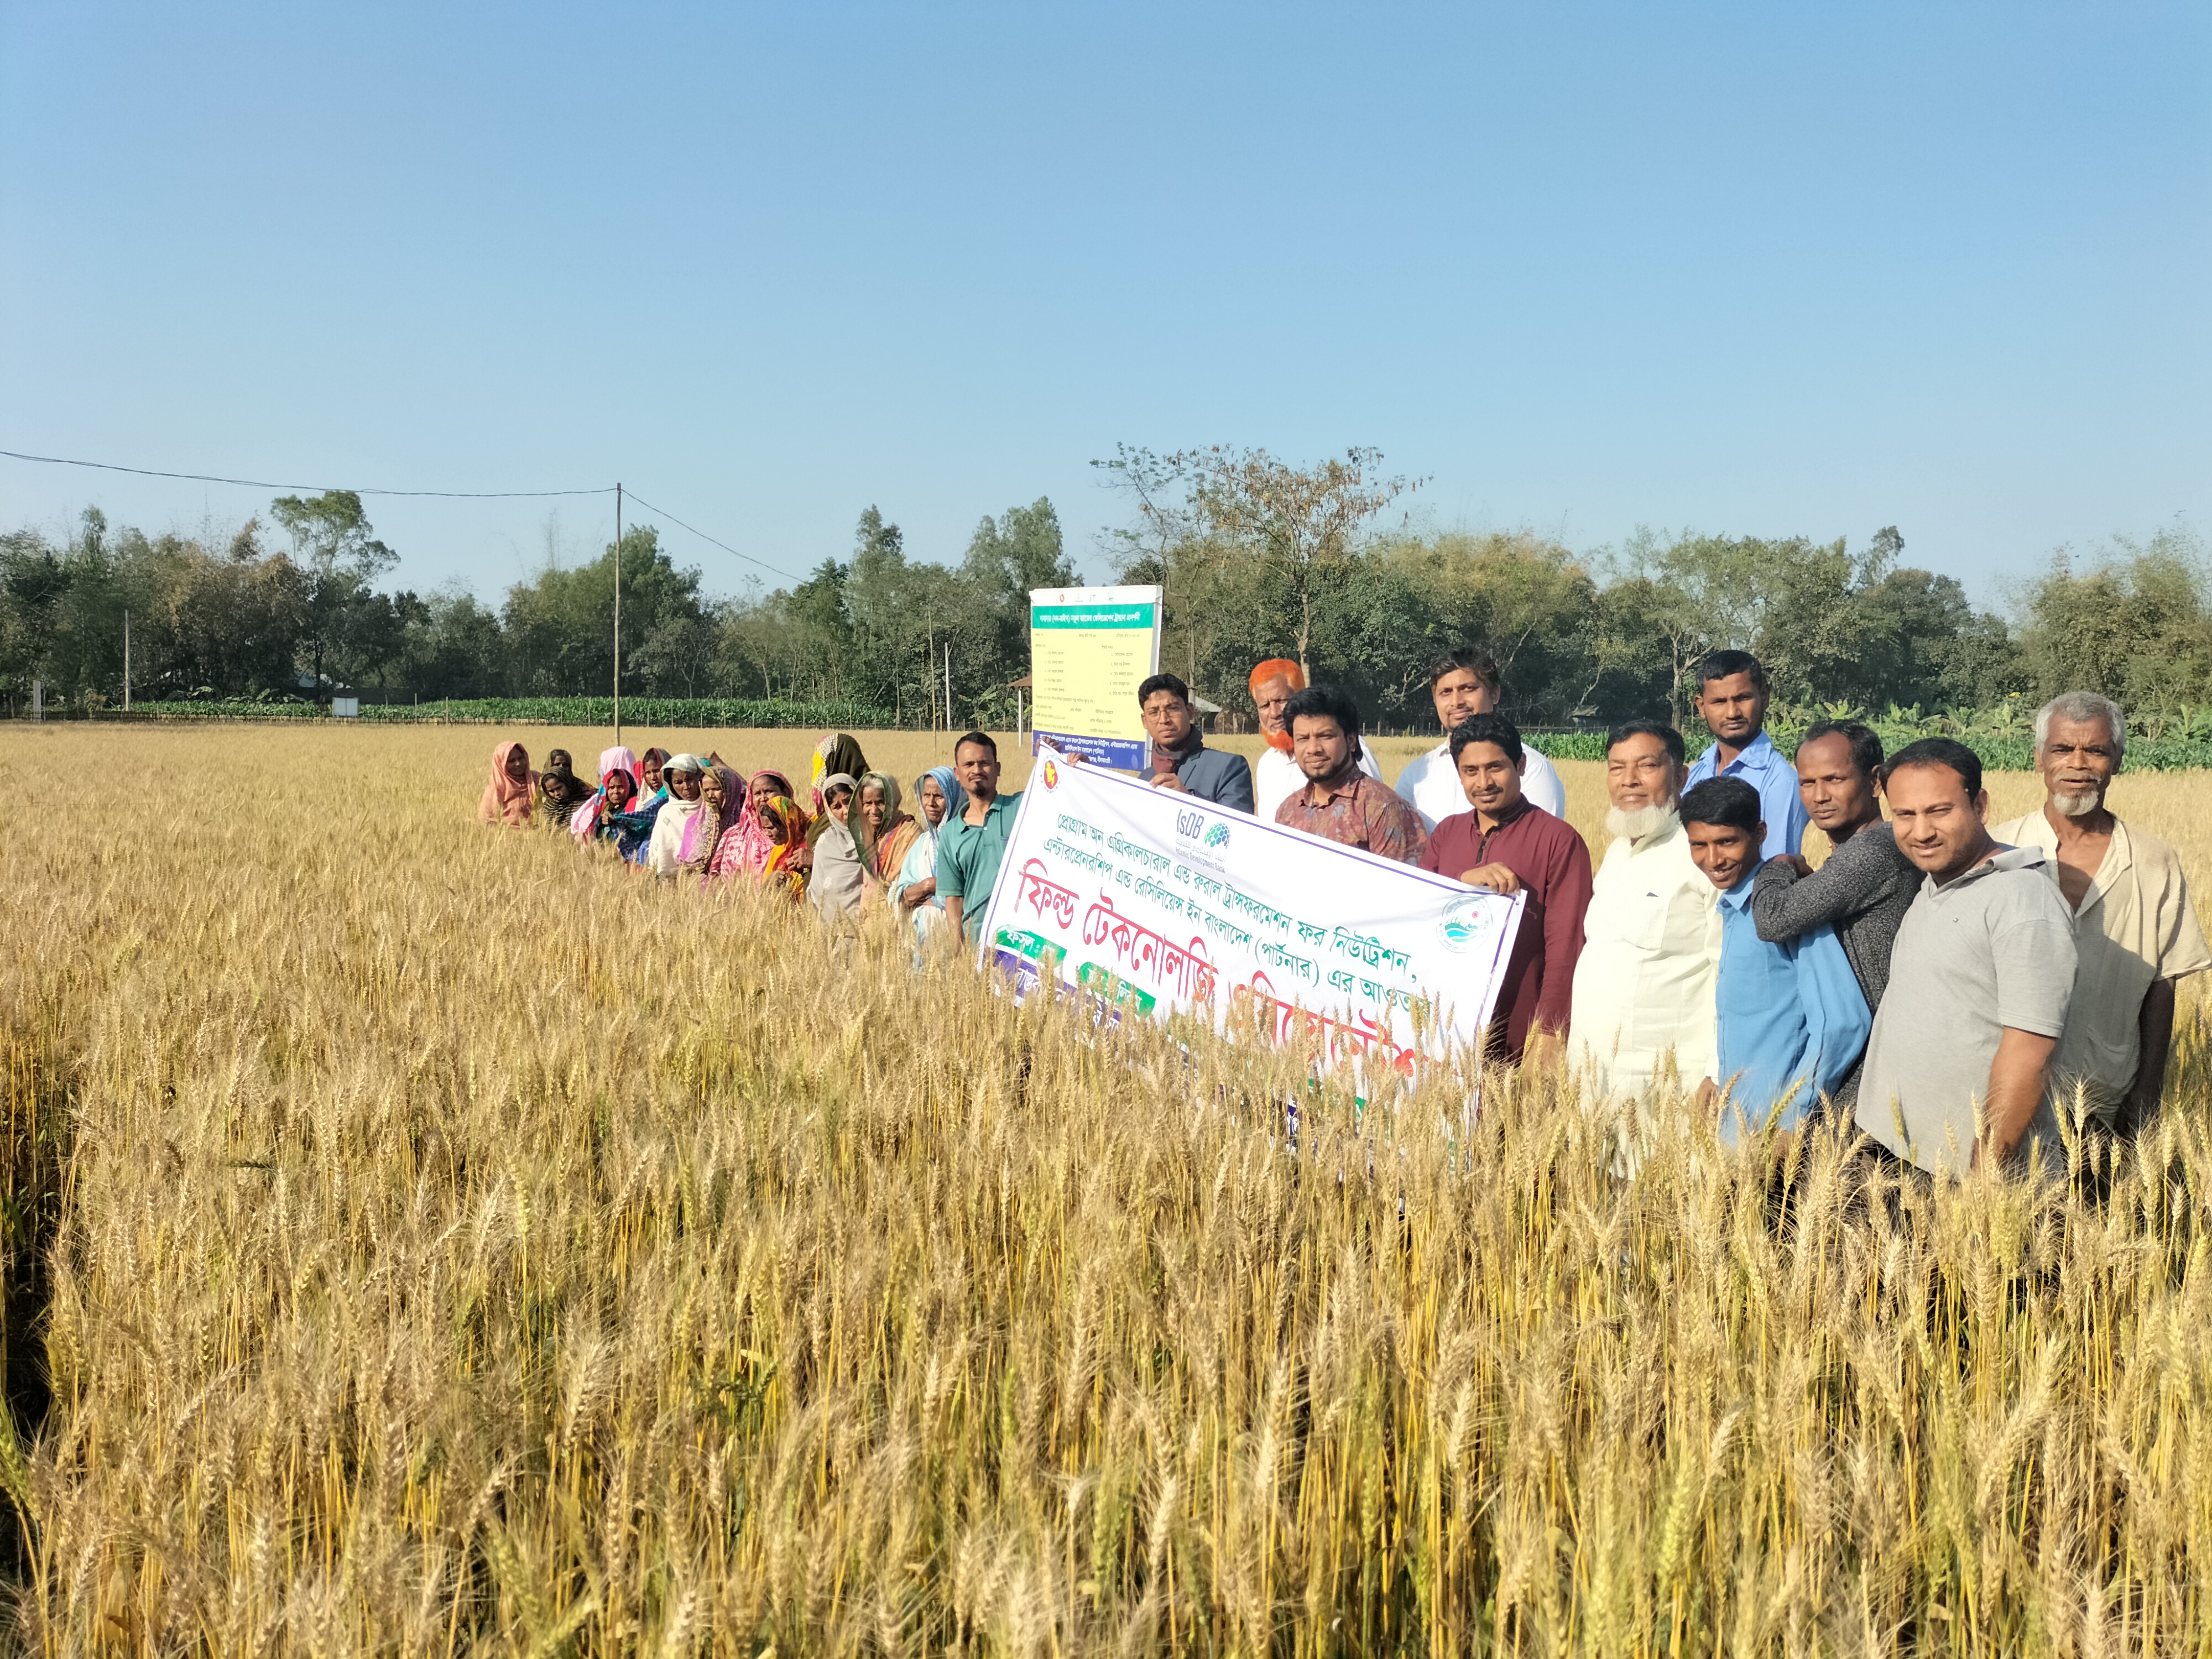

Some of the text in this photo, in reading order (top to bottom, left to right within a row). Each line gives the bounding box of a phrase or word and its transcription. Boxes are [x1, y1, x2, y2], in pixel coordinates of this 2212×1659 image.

[1176, 847, 1225, 874] Islamic Development Bank
[1177, 808, 1204, 839] IsDB
[1044, 834, 1113, 881] এন্টারপ্রেনরশিপ
[1115, 869, 1133, 888] এন্ড
[1135, 875, 1185, 916] রেসিলিয়েন্স
[1187, 895, 1202, 927] ইন
[1205, 911, 1253, 953] বাংলাদেশ
[1255, 937, 1319, 988] (পার্টনার)
[1327, 970, 1355, 995] এর
[1057, 813, 1088, 840] প্রোগ্রাম
[1089, 825, 1104, 848] অন
[1107, 832, 1172, 877] এগ্রিকালচারাল
[1174, 864, 1192, 884] এন্ড
[1194, 871, 1223, 902] রুরাল
[1223, 879, 1293, 937] ট্রান্সফরমেশন
[1297, 920, 1328, 948] ফর
[1005, 928, 1035, 952] ফসল
[1014, 858, 1080, 930] ফিল্ড
[1083, 887, 1219, 1003] টেকনোলজি
